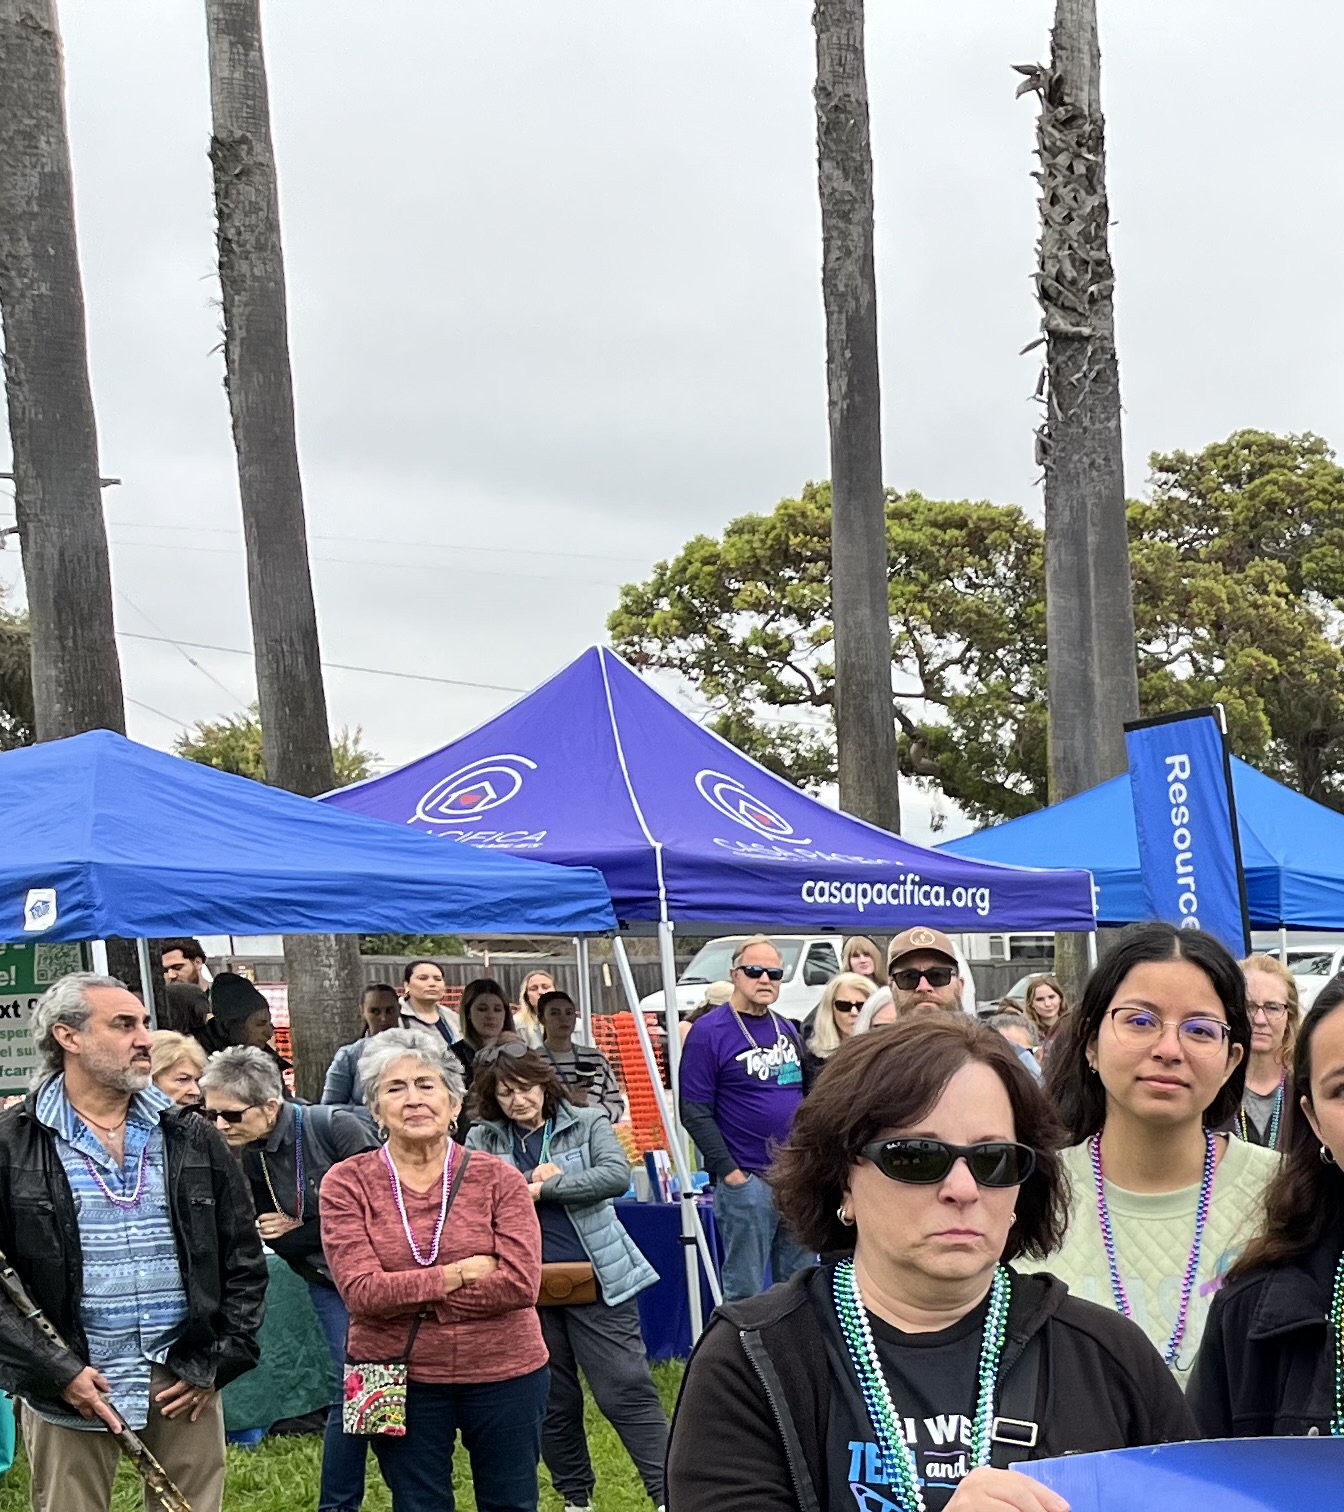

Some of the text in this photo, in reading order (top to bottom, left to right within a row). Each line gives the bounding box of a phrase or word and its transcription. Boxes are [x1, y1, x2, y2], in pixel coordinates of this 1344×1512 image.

[801, 873, 990, 916] casapacifica.org
[903, 1418, 918, 1444] I
[925, 1454, 970, 1478] and
